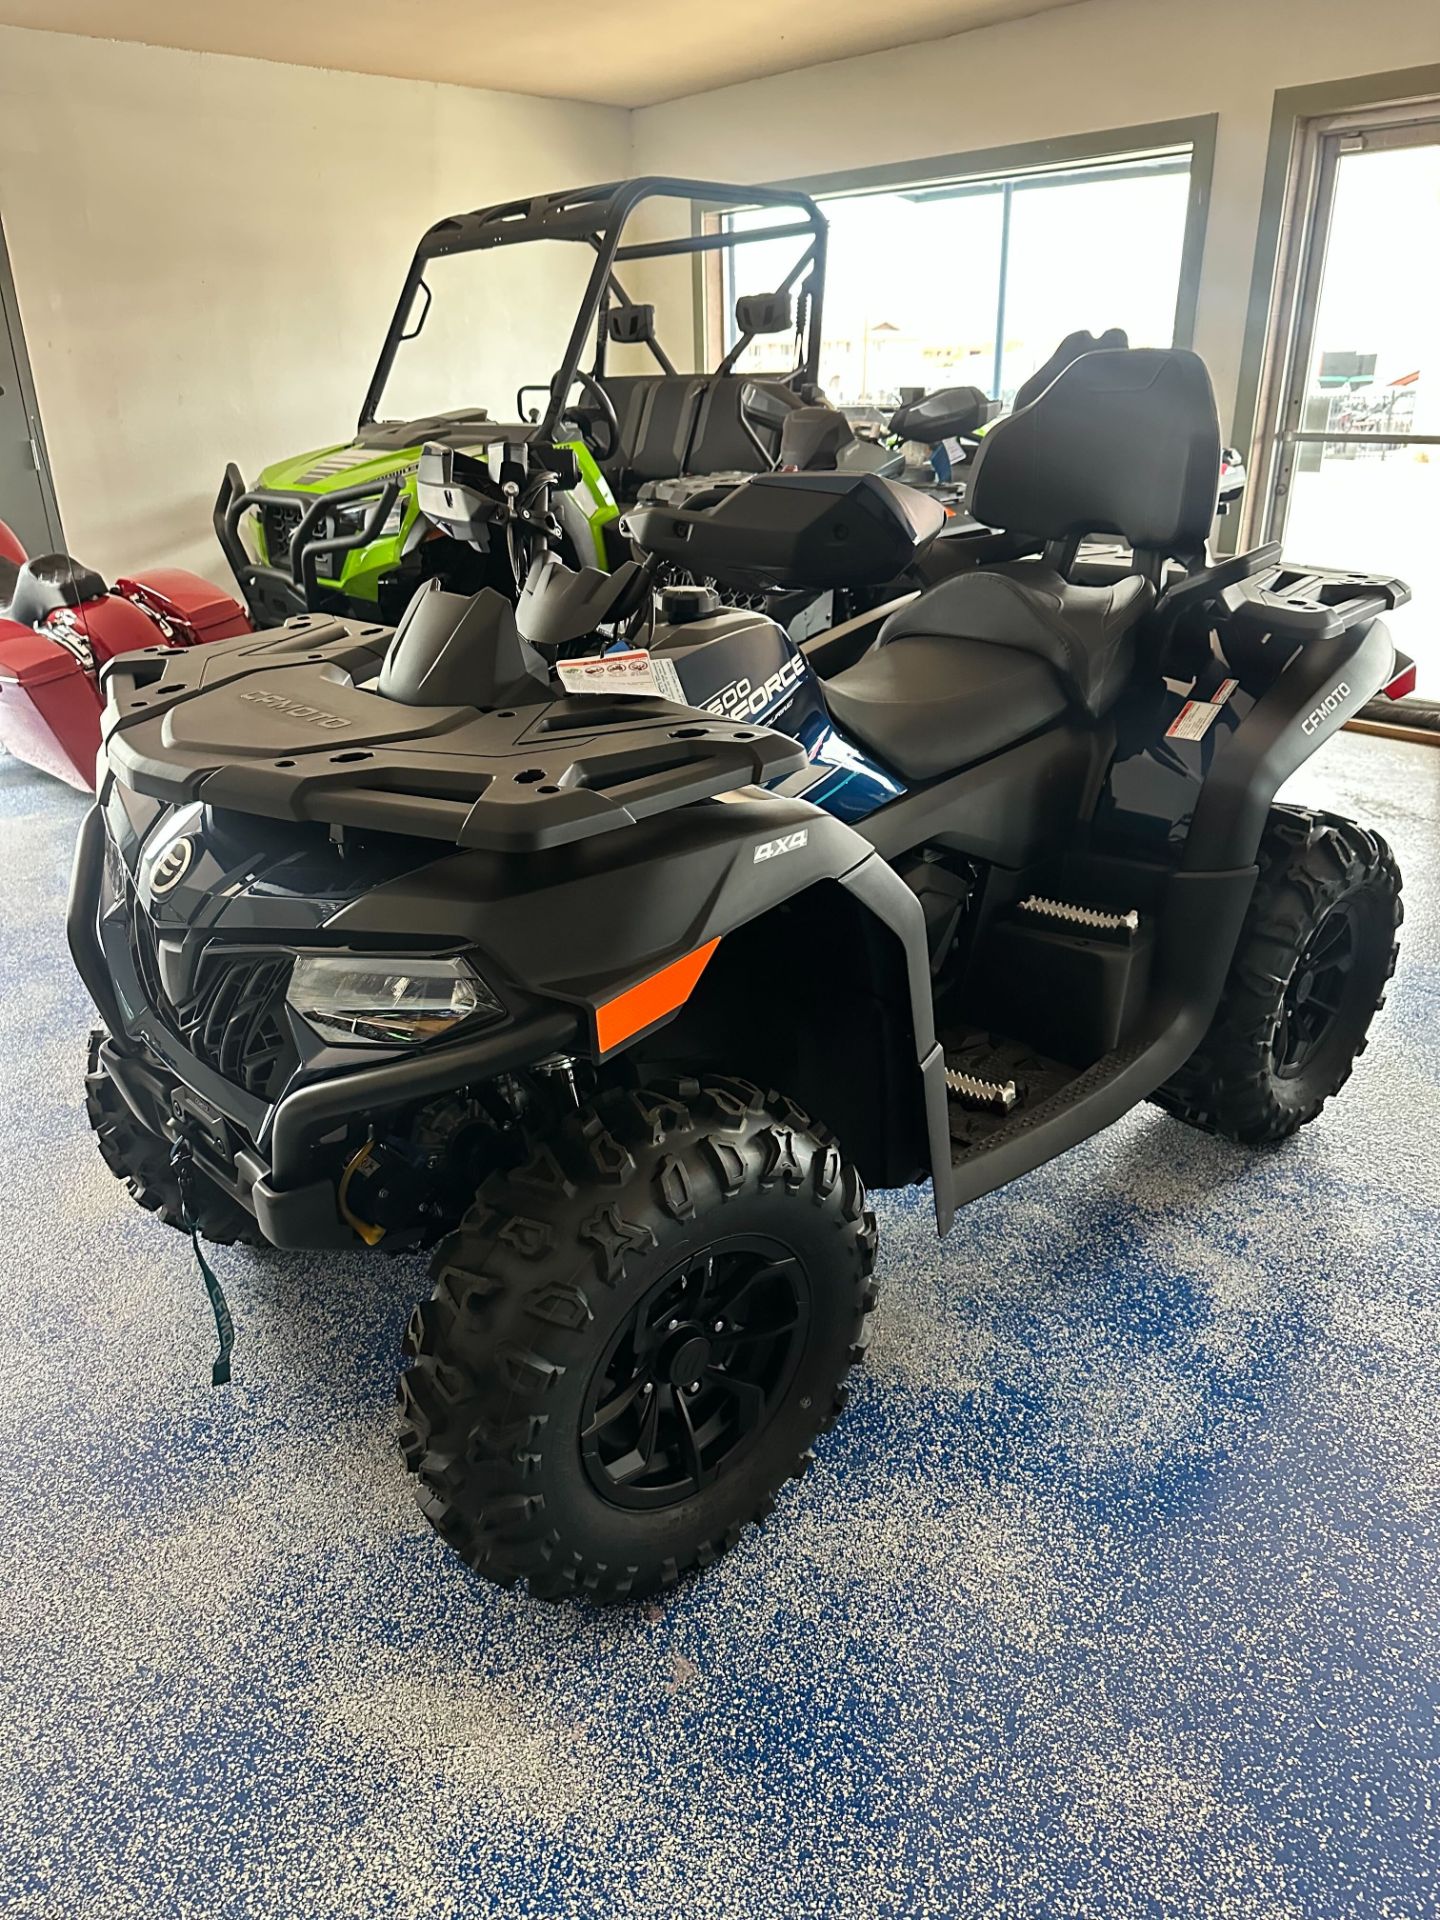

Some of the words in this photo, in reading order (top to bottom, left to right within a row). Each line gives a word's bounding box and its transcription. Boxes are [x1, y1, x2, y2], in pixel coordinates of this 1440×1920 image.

[240, 690, 352, 729] CFMOTO
[727, 653, 806, 720] FORCE
[1301, 681, 1351, 735] CFMOTO
[754, 829, 808, 863] 4X4
